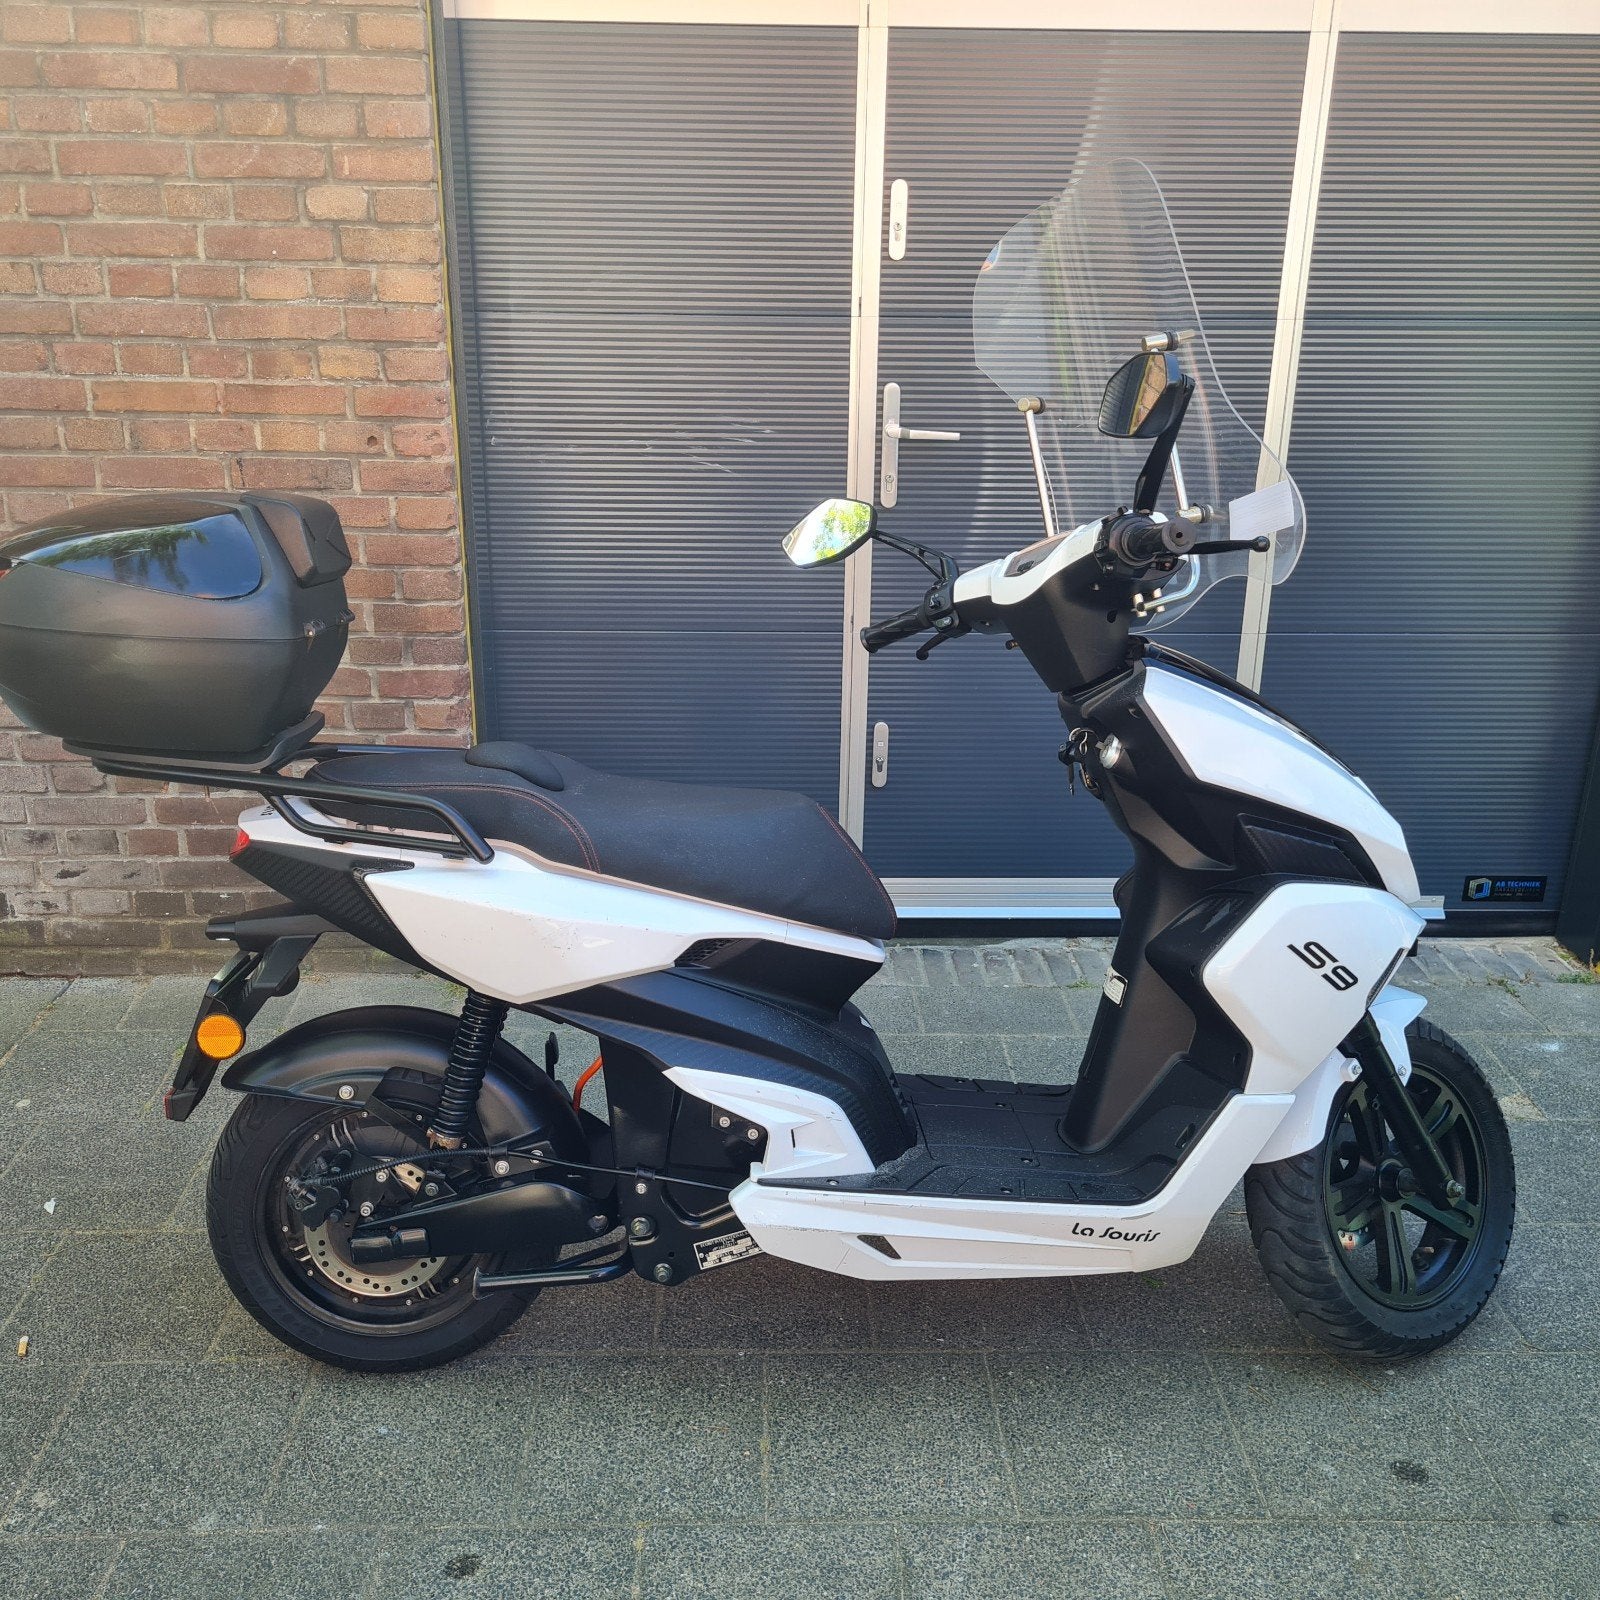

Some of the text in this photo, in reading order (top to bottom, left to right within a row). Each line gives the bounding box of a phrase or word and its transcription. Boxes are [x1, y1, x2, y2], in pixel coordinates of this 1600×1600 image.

[1286, 941, 1359, 991] S9
[1071, 1222, 1161, 1242] La Souris
